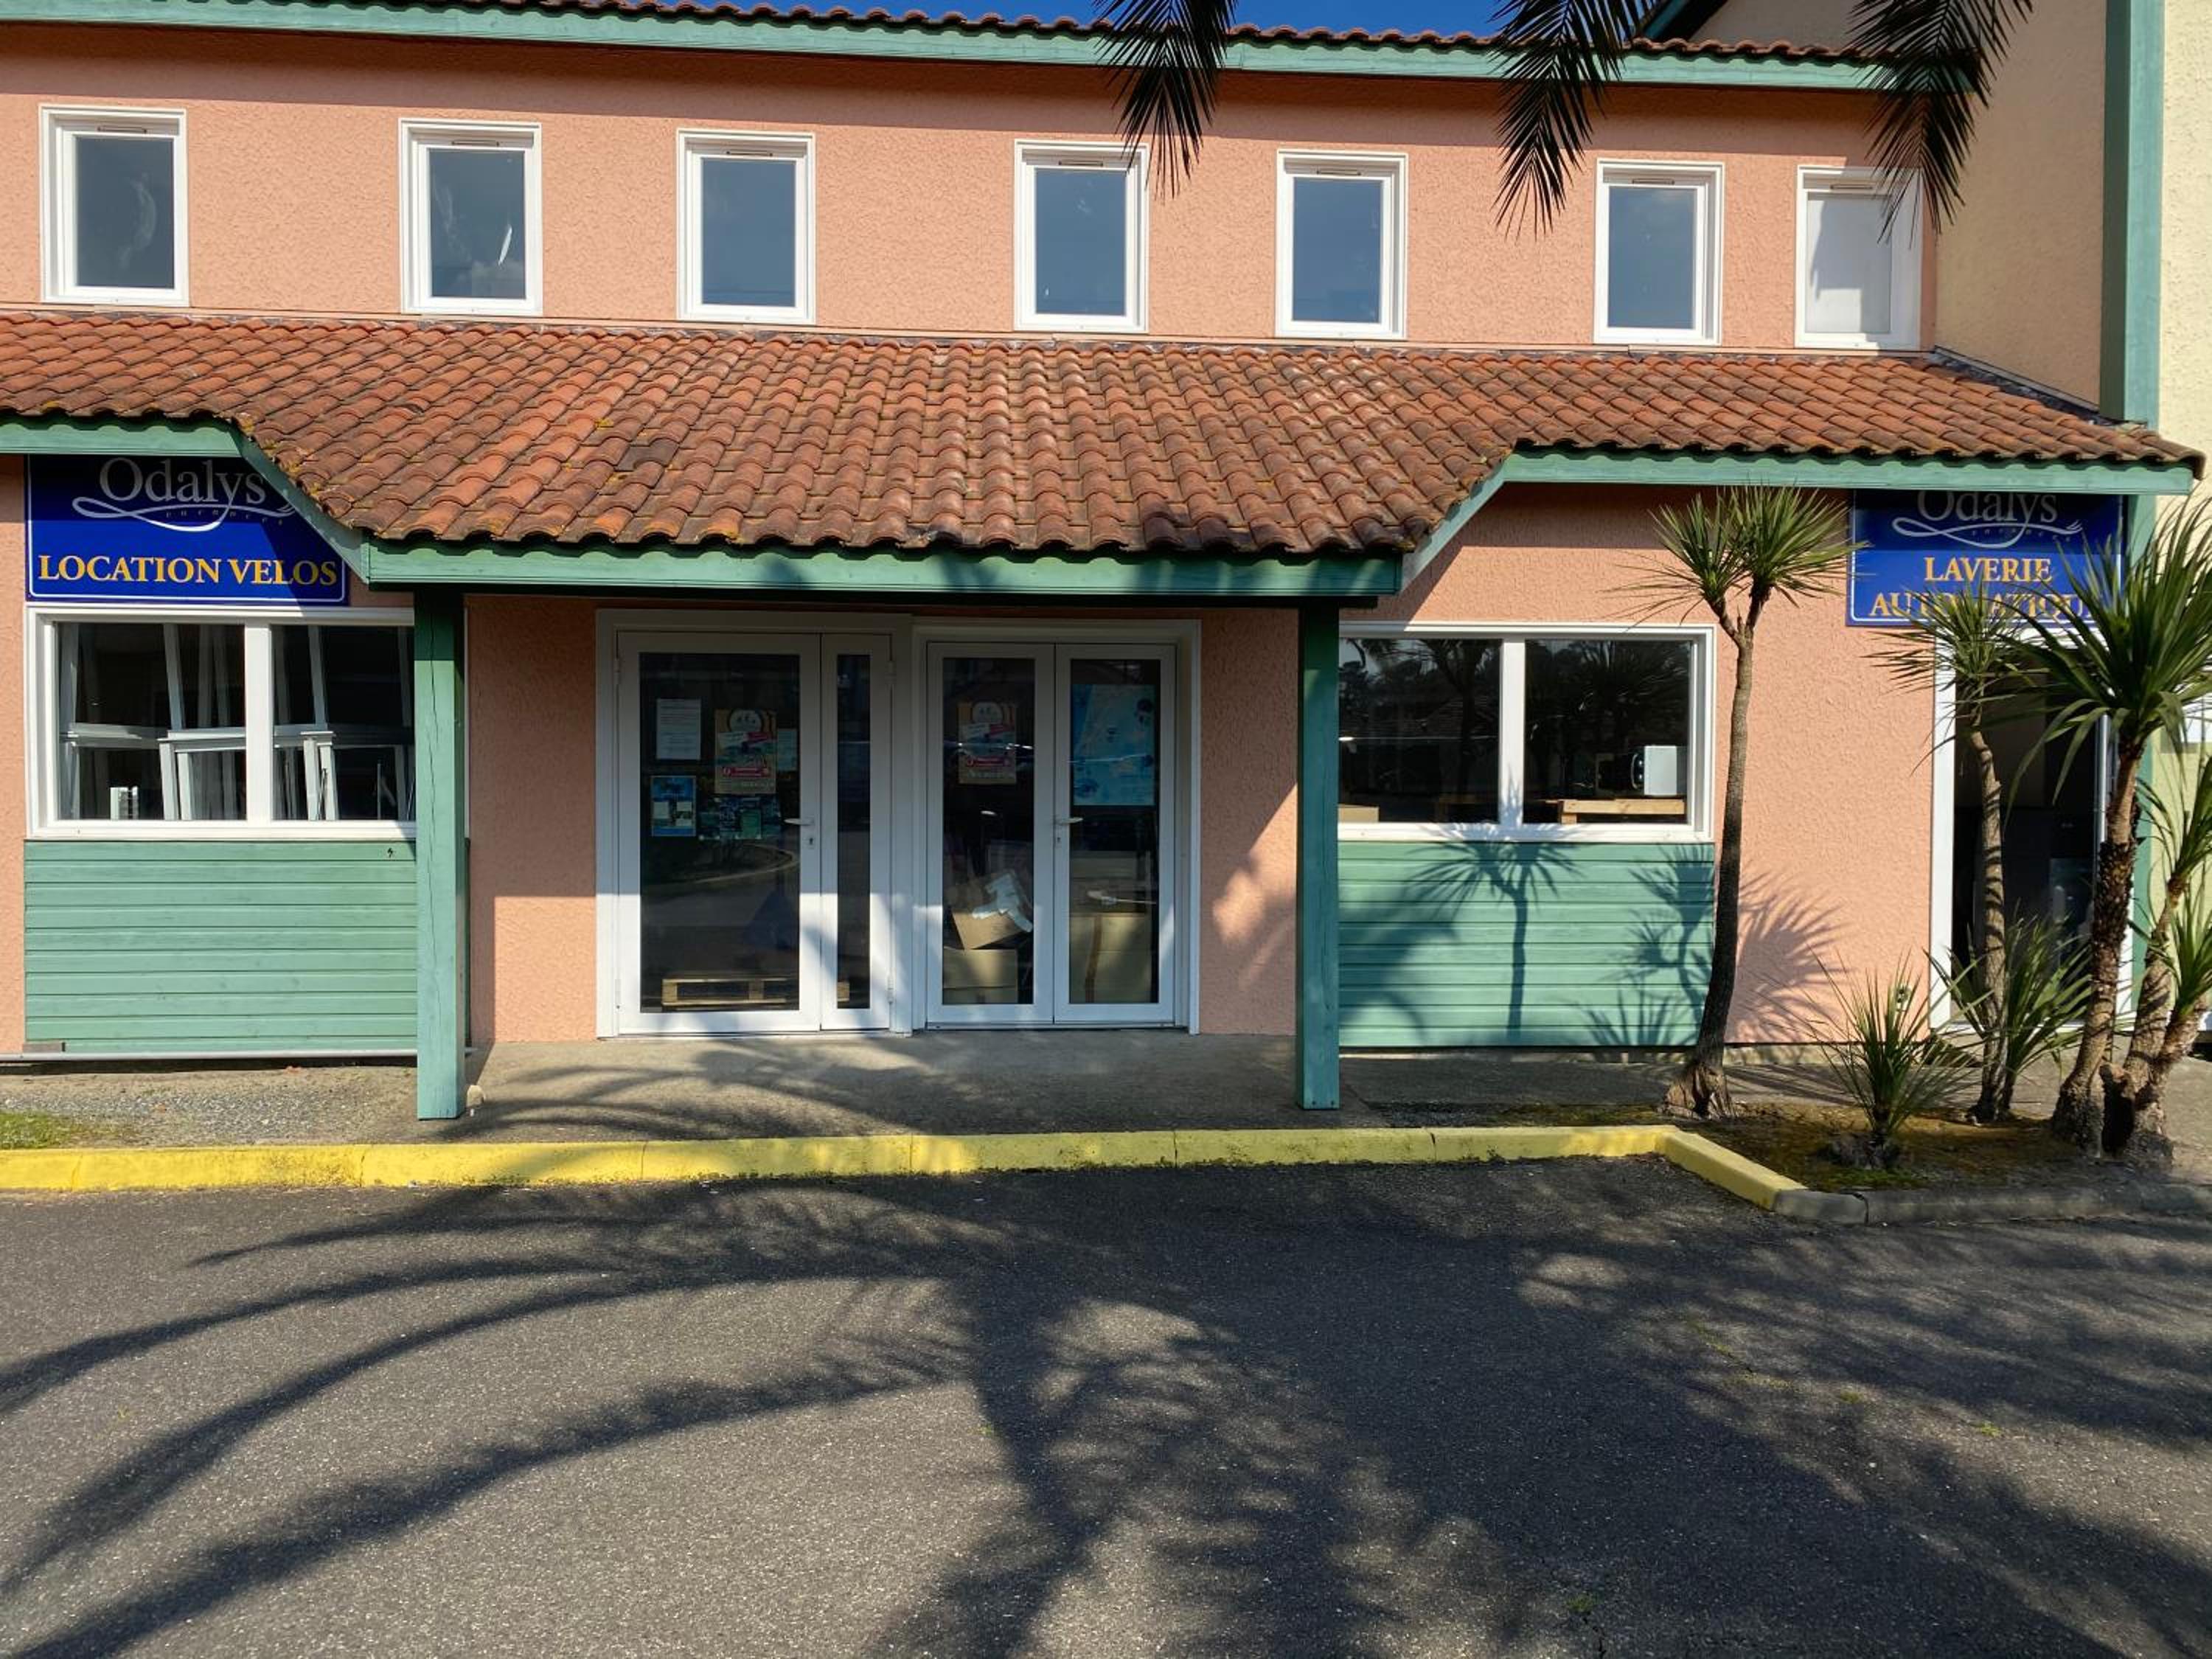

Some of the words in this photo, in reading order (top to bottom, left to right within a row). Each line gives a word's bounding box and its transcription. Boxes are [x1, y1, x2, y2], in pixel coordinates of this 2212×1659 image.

[99, 456, 267, 507] Odalys
[1916, 491, 2059, 524] Odalys
[38, 554, 222, 584] LOCATION
[228, 559, 337, 586] VELOS
[1924, 557, 2053, 582] LAVERIE
